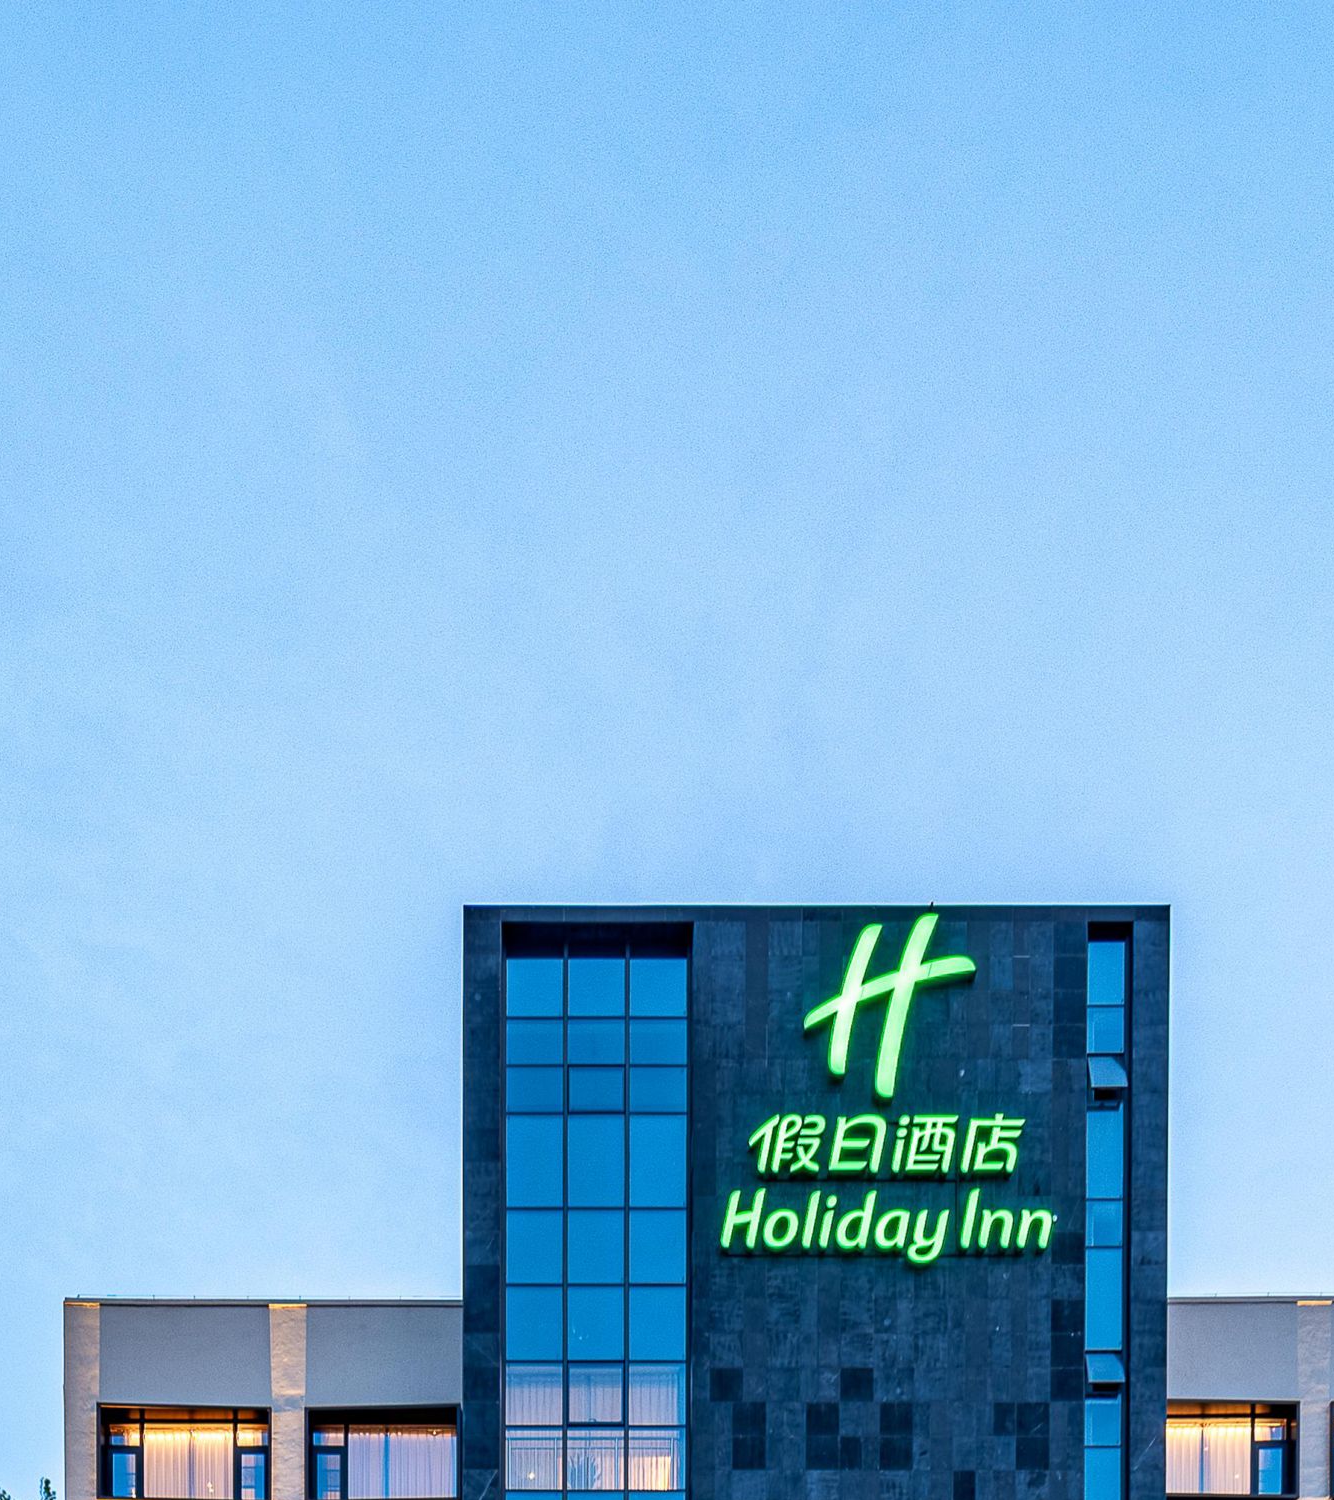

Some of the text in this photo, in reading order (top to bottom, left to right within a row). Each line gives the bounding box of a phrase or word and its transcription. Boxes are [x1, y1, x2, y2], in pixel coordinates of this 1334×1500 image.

[803, 913, 976, 1098] H
[748, 1113, 1026, 1175] 假日酒店
[720, 1188, 1053, 1264] Holiday Inn
